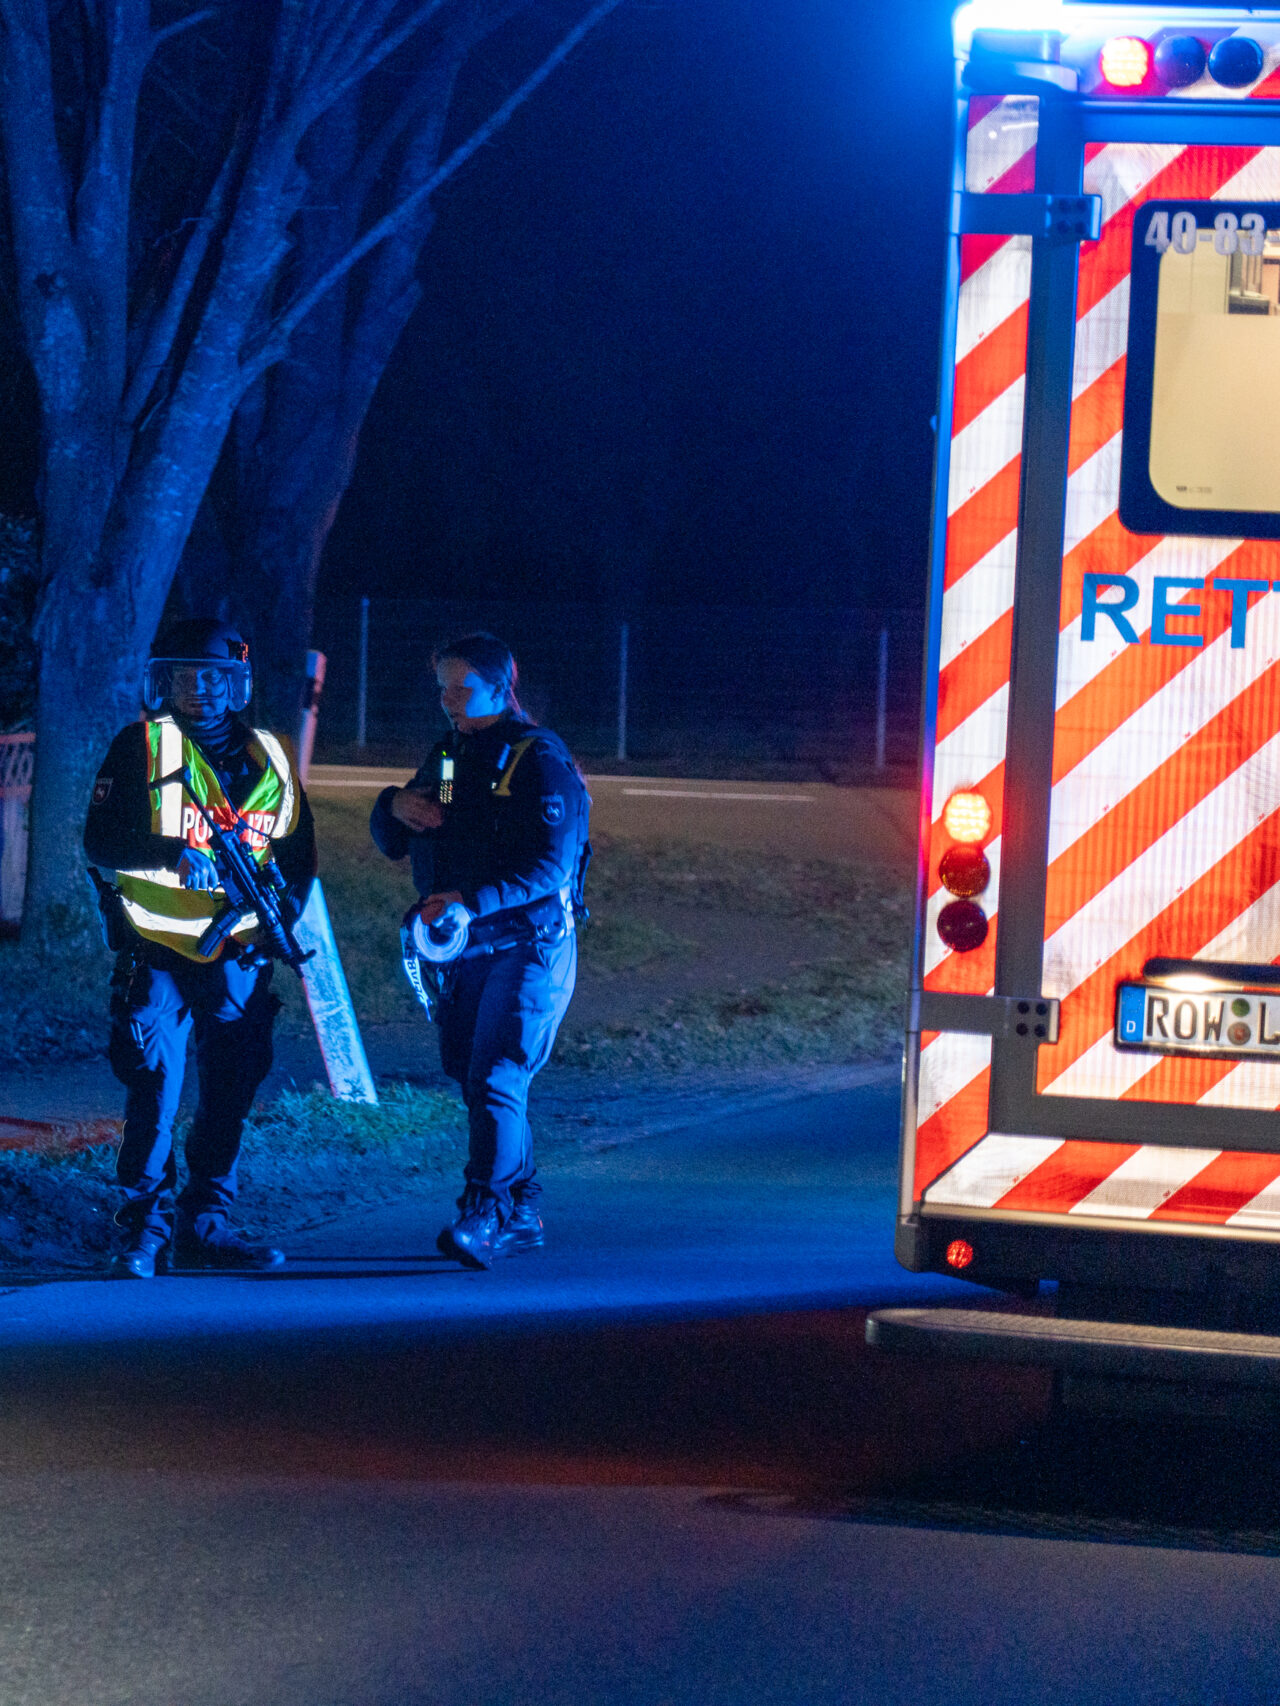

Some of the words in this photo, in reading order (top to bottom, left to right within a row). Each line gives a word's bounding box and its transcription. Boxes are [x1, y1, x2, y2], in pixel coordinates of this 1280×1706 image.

[1080, 572, 1280, 649] RET
[1126, 1020, 1136, 1033] D
[1146, 994, 1225, 1041] ROW
